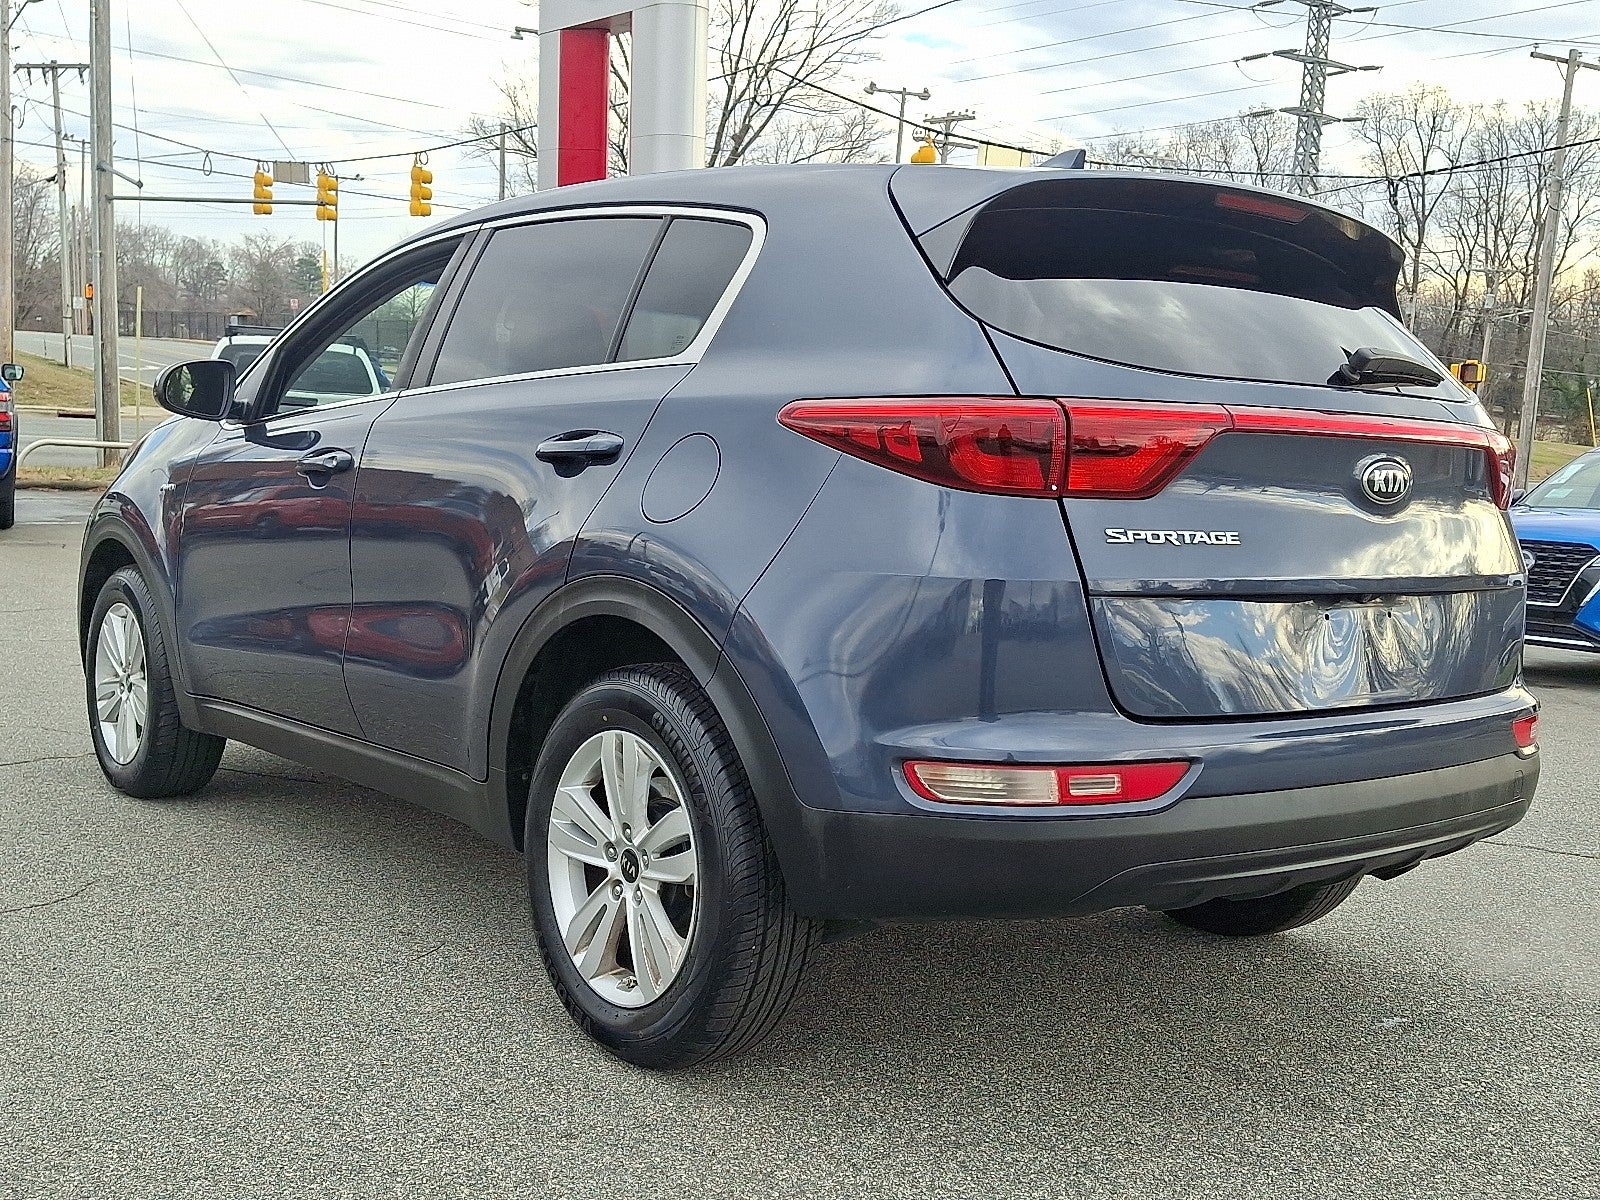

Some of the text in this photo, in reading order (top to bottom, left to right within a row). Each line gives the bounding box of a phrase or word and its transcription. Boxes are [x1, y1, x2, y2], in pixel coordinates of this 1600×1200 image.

[1373, 469, 1406, 493] KIA
[1104, 527, 1241, 546] SPORTAGE
[622, 855, 636, 878] KIA
